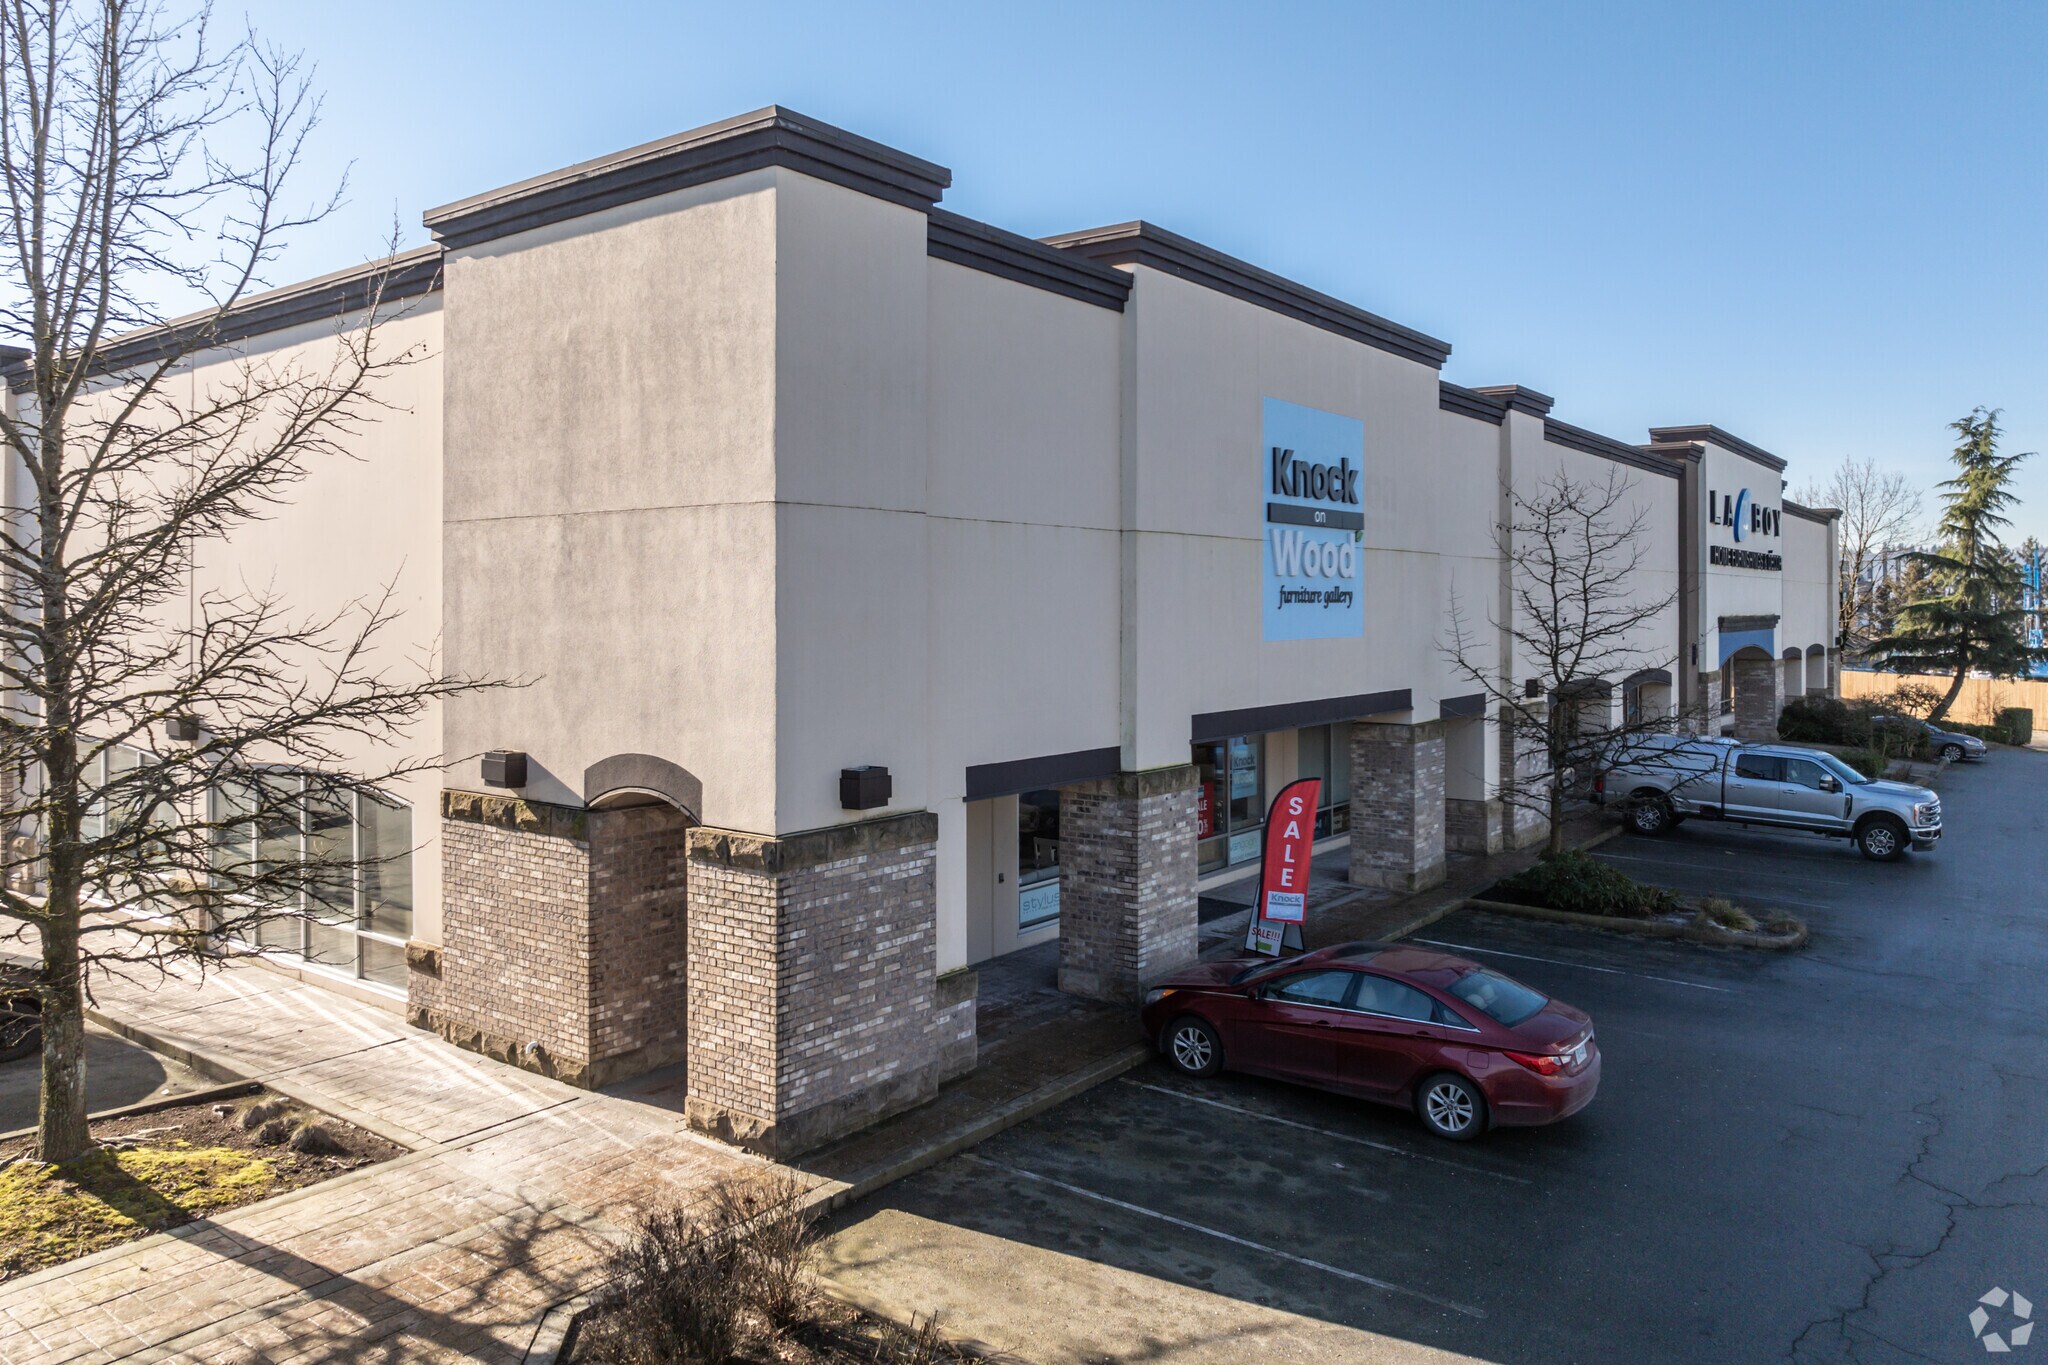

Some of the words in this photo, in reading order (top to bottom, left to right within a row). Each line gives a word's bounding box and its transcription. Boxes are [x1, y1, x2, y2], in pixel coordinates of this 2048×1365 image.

[1272, 446, 1359, 505] Knock
[1314, 510, 1326, 523] on
[1270, 528, 1356, 579] Wood
[1278, 585, 1322, 610] furniture
[1323, 586, 1354, 609] gallery
[1281, 796, 1303, 887] SALE
[1271, 893, 1301, 903] Knock
[1251, 927, 1281, 942] SALE!!!
